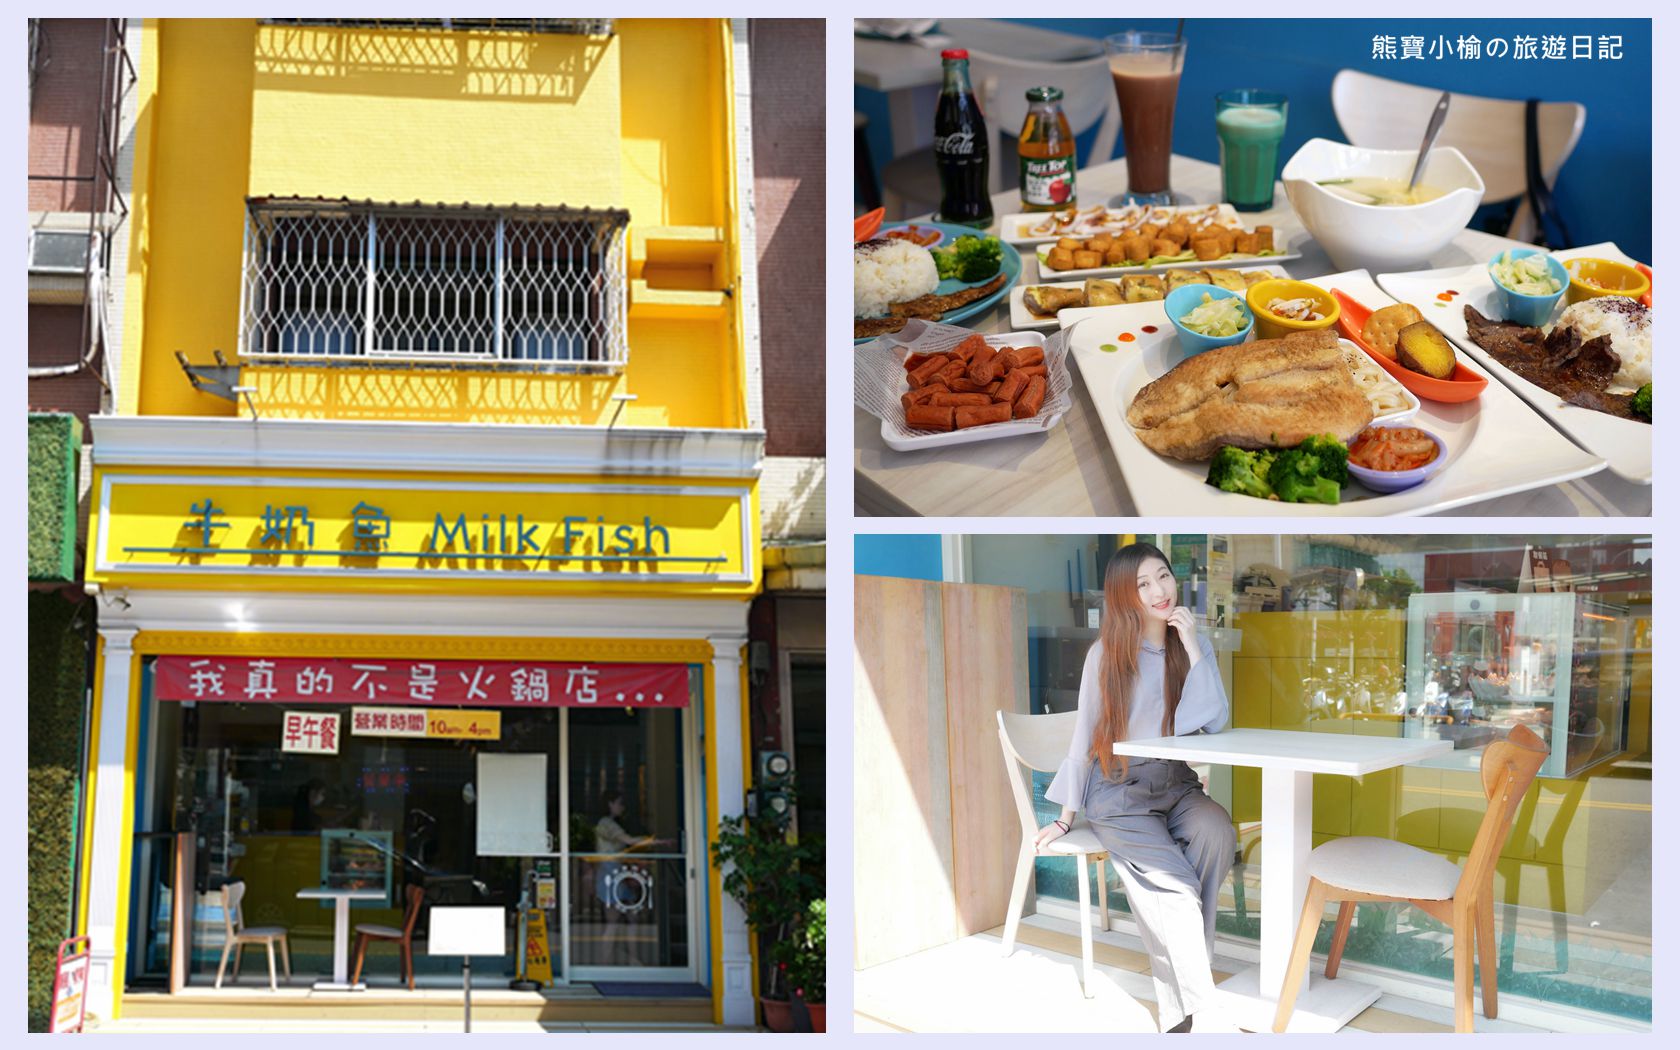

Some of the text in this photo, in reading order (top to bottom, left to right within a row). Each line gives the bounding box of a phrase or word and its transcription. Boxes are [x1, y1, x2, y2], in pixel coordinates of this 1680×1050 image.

[182, 498, 670, 554] 牛奶魚 Milk Fish
[285, 715, 337, 749] 早午餐
[354, 711, 425, 732] 營業時間
